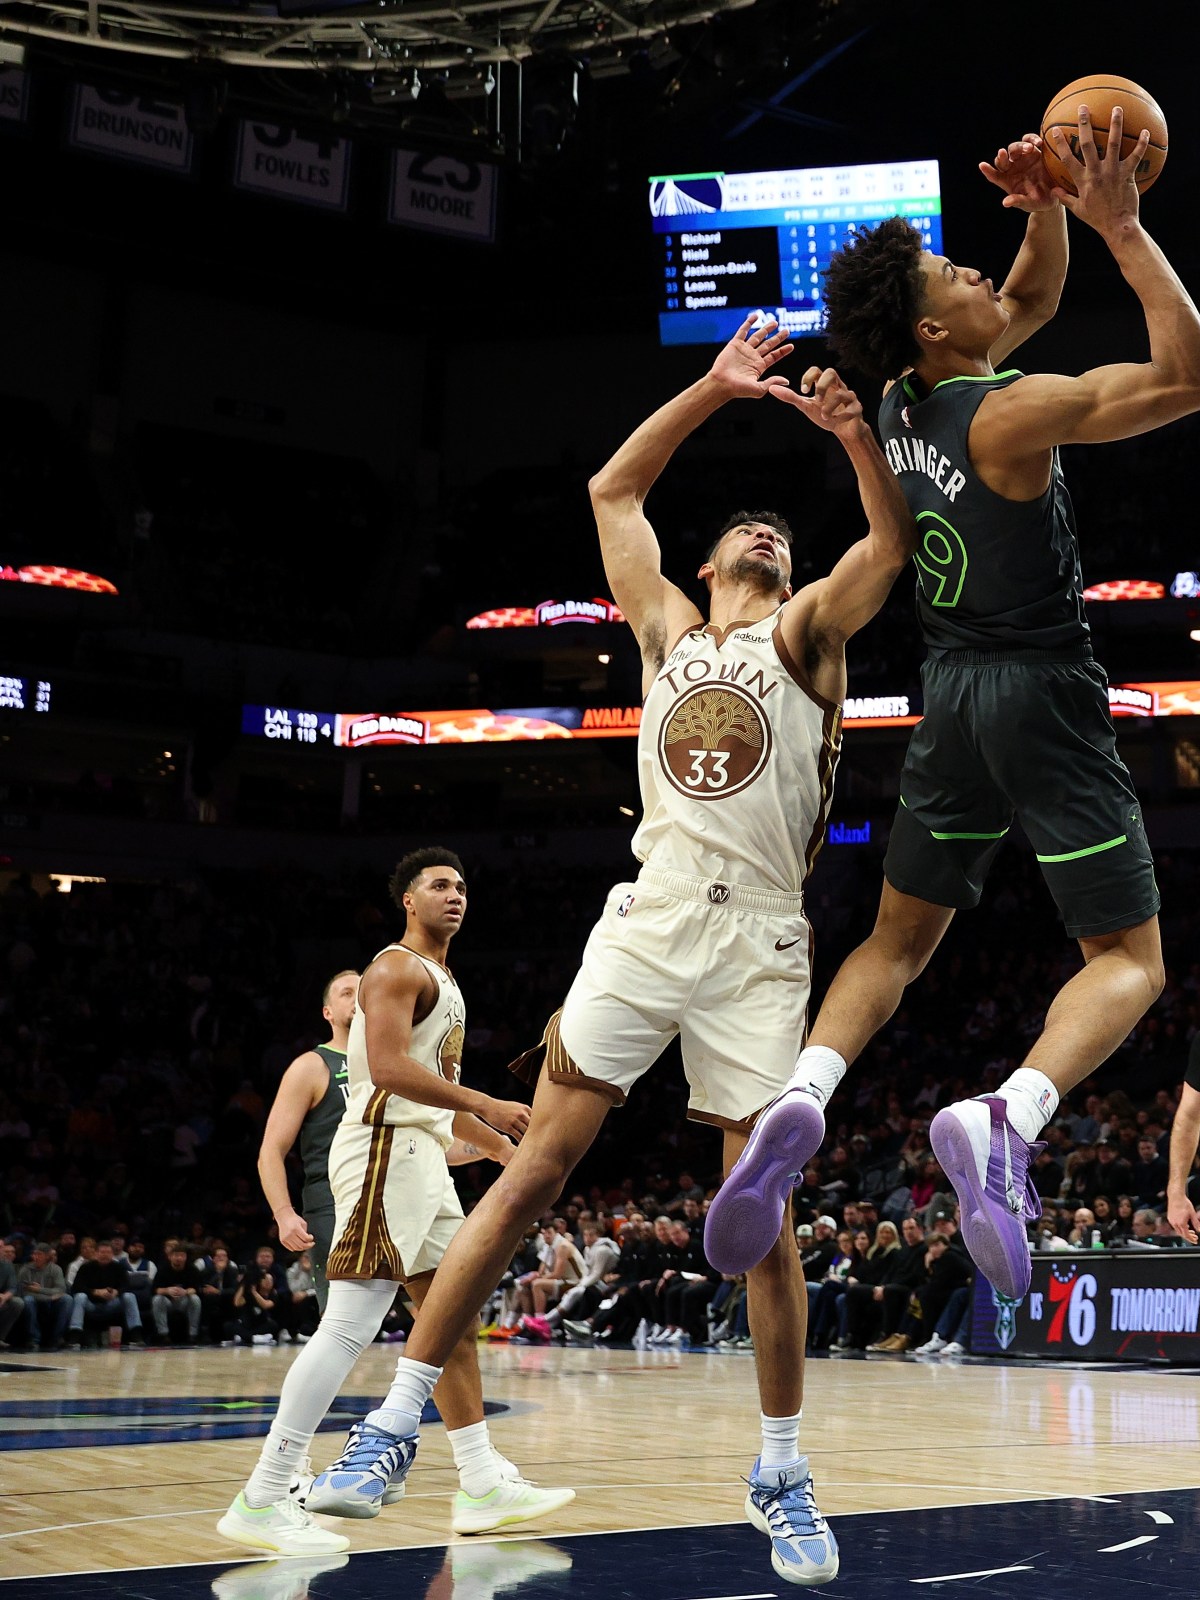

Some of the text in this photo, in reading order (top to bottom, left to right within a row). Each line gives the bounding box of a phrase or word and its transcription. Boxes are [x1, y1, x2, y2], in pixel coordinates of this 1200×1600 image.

[82, 106, 183, 150] BRUNSON
[254, 152, 330, 187] FOWLES
[409, 188, 475, 219] MOORE
[681, 231, 721, 247] Richard
[682, 248, 709, 262] Hield
[683, 261, 757, 278] Jackson-Davis
[685, 296, 728, 310] Spencer
[913, 510, 968, 608] 9
[541, 601, 607, 622] RED BARON
[668, 649, 692, 666] The
[658, 659, 778, 700] TOWN
[265, 708, 292, 726] LAL
[352, 716, 423, 740] RED BARON
[264, 723, 292, 740] CHI
[320, 723, 331, 738] 4
[685, 749, 731, 788] 33
[829, 821, 870, 844] Island
[1029, 1292, 1044, 1321] VS
[1046, 1273, 1098, 1347] 76
